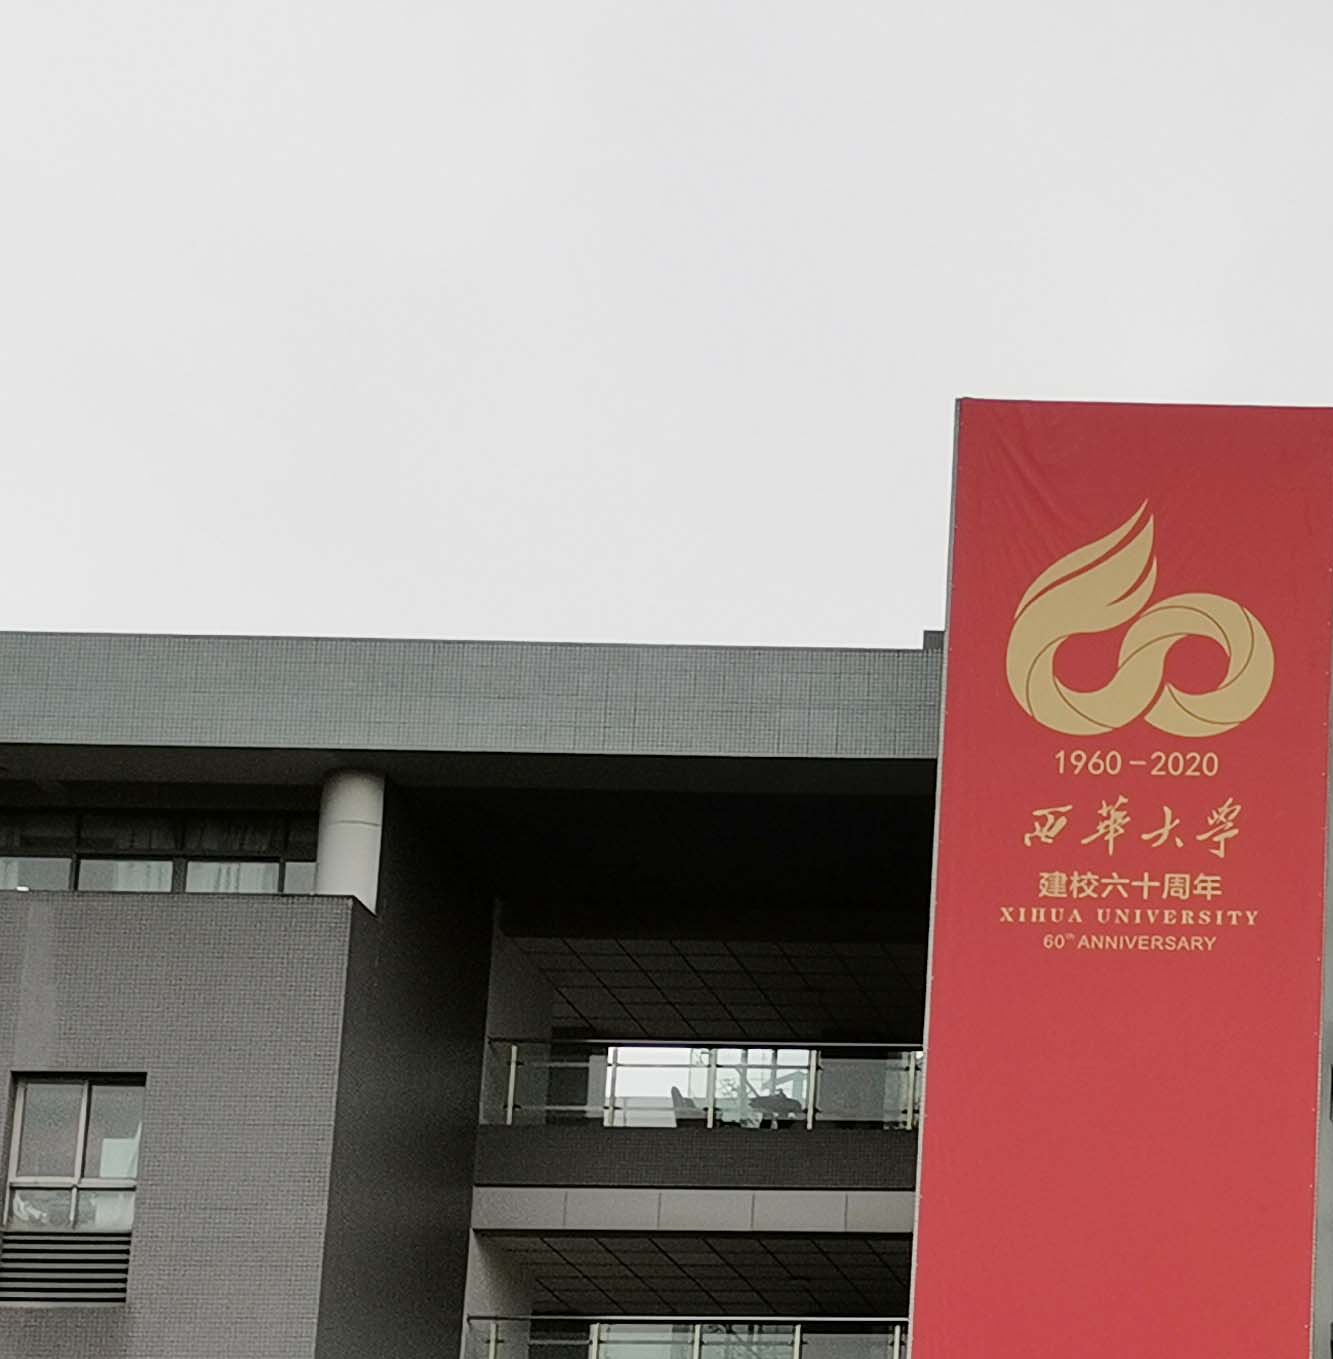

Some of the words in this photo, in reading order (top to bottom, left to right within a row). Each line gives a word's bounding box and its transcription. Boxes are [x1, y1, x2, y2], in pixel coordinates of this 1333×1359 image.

[1038, 871, 1222, 900] 建校六十周年
[1000, 907, 1083, 923] XIHUA
[1097, 908, 1259, 926] UNIVERSITY
[1077, 934, 1217, 951] ANNIVERSARY
